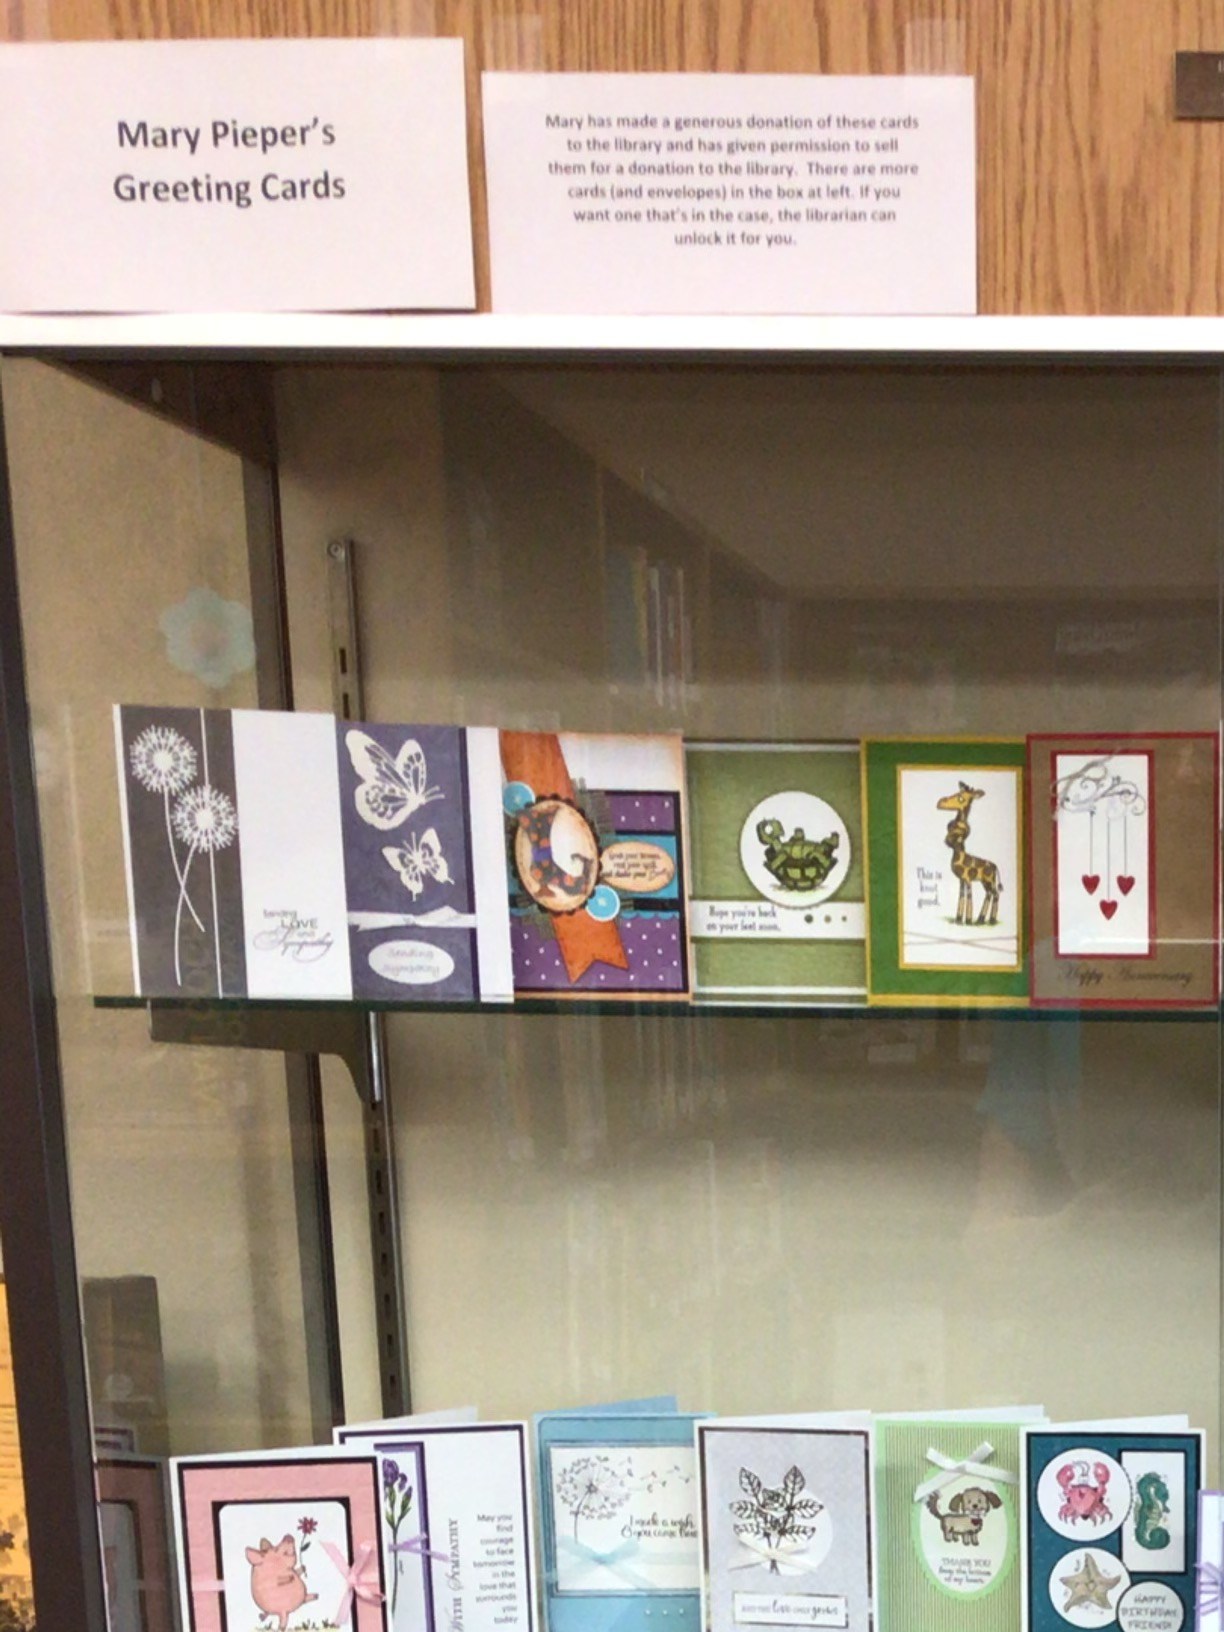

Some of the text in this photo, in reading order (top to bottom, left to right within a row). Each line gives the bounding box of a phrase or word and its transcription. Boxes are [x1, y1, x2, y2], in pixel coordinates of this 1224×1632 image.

[546, 114, 919, 131] Mary has made a generous donation of these cards
[117, 117, 336, 155] Mary Pieper's
[567, 138, 899, 154] to the library and has given permission to sell
[548, 161, 919, 178] them for a donation to the library. There are more
[113, 171, 345, 208] Greeting Cards
[568, 184, 900, 202] cards (and envelopes) in the box at left. If you
[573, 208, 896, 224] want one that's in the case, the librarian can
[674, 231, 797, 248] unlock it for you.
[916, 867, 942, 880] This is
[281, 918, 319, 929] LOVE
[720, 922, 738, 933] your
[1134, 1595, 1166, 1604] HAPPY
[1121, 1607, 1177, 1617] BIRTHDAY
